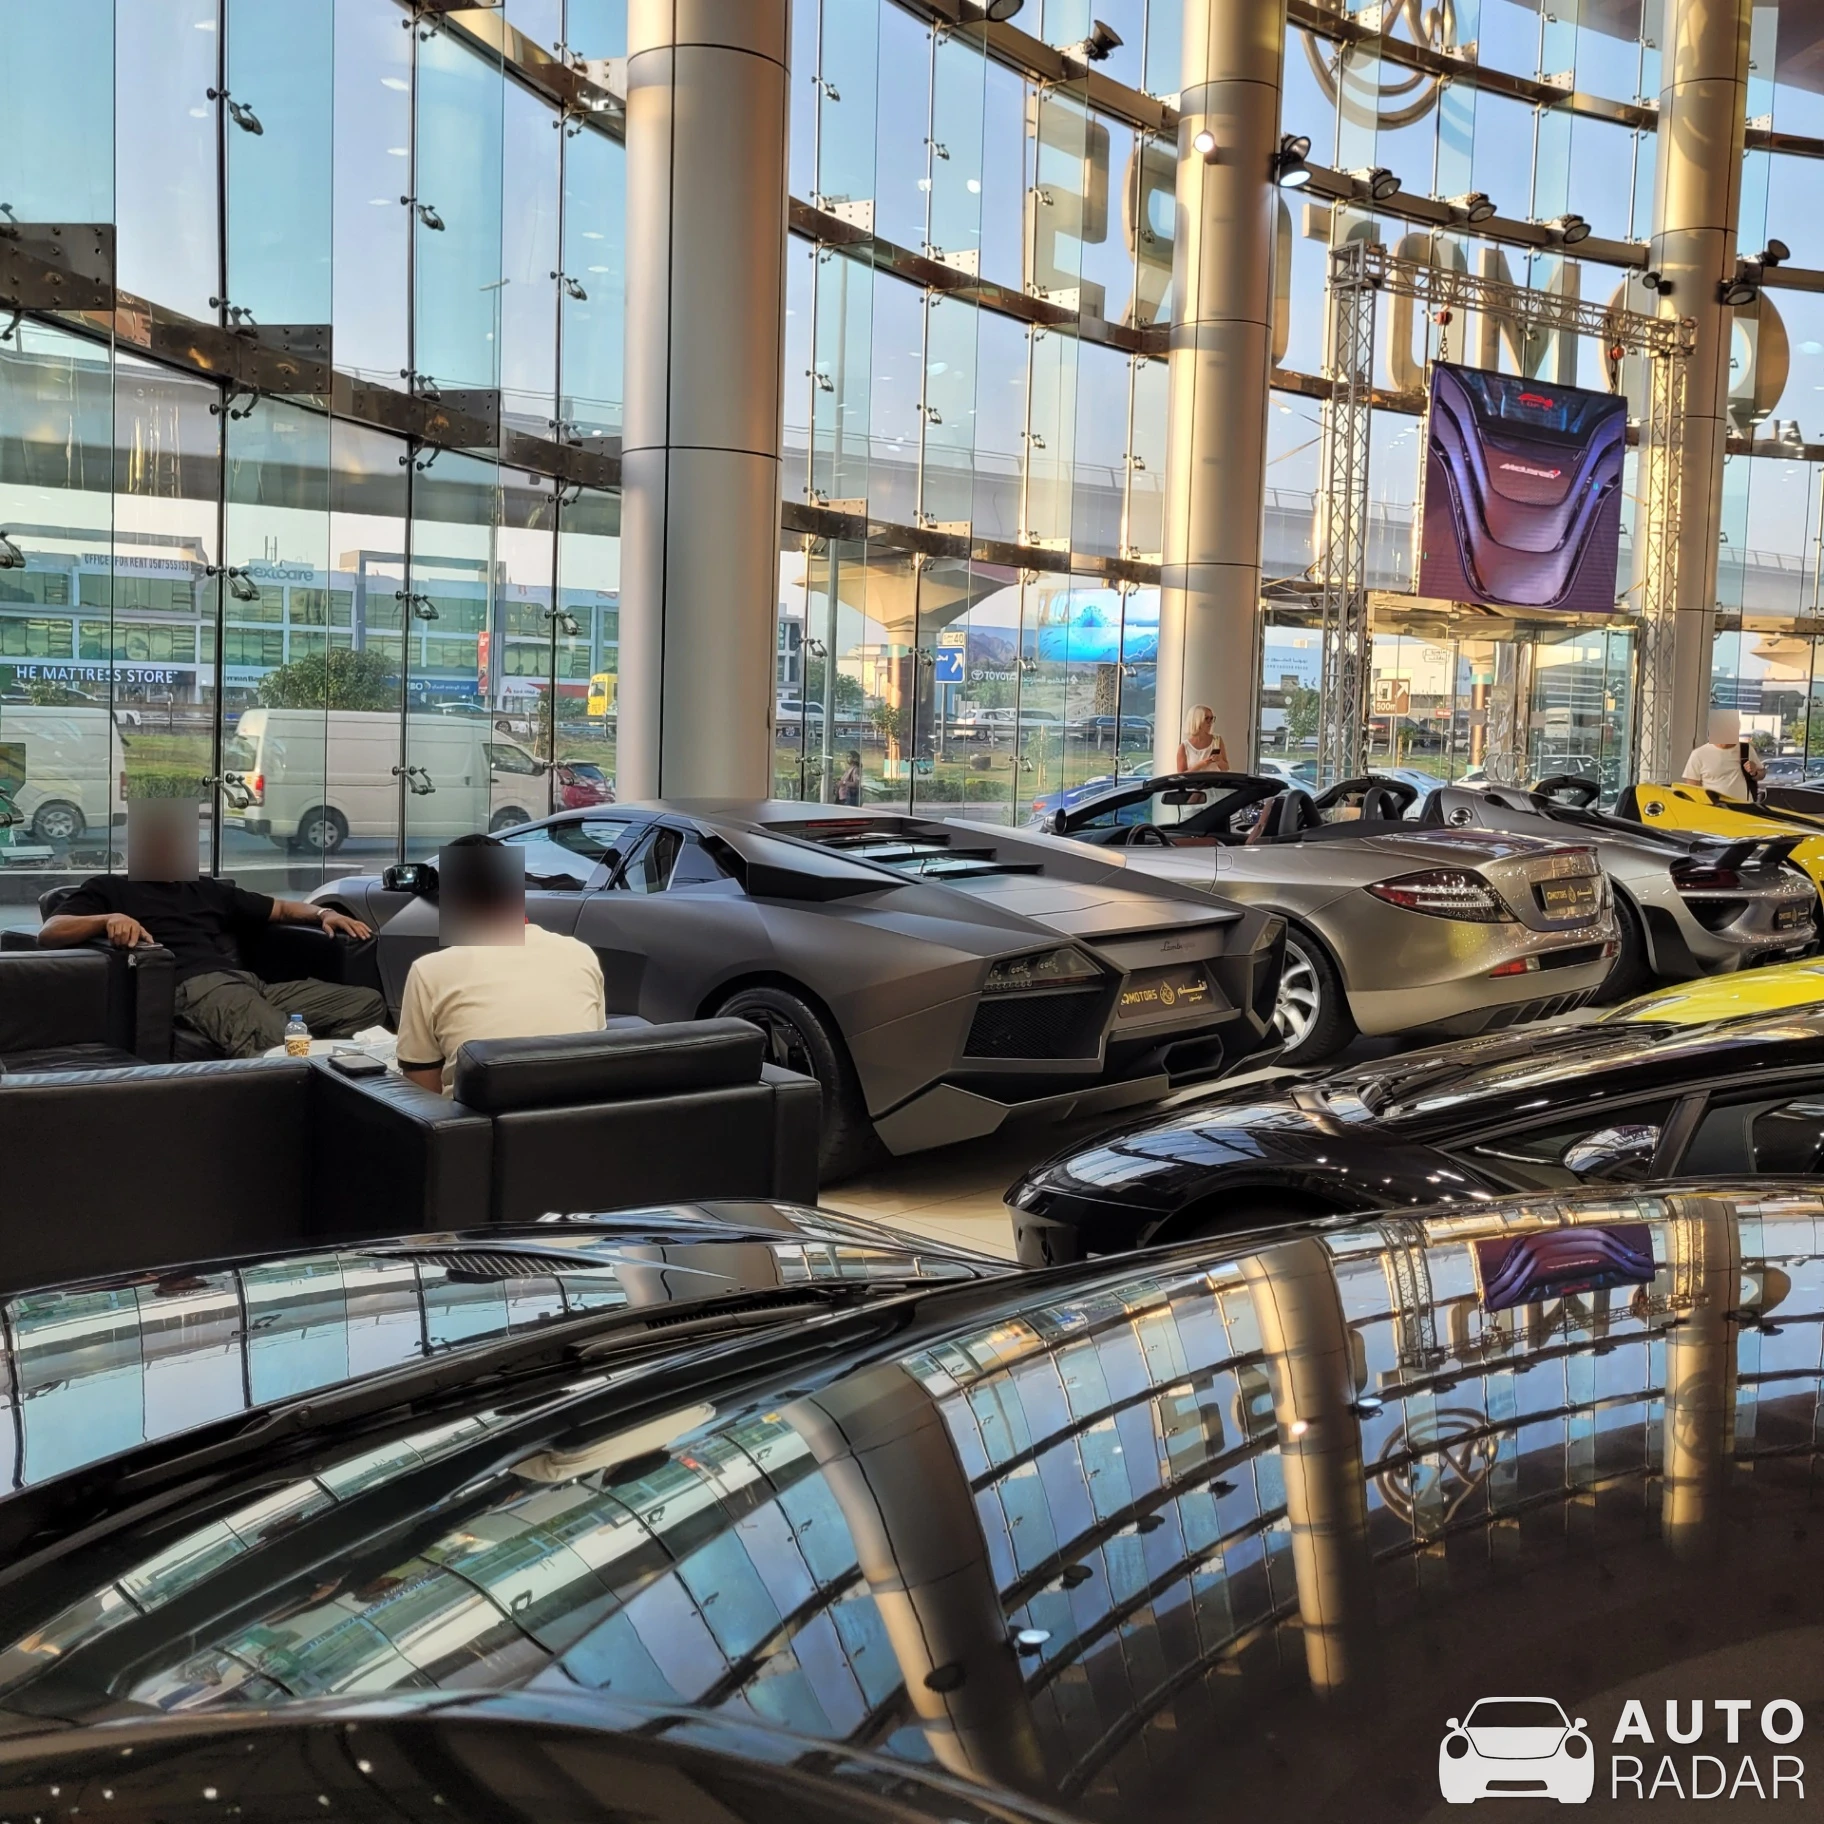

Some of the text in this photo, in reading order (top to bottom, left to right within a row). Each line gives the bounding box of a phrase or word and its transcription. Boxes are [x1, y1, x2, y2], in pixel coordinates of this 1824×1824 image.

[130, 557, 147, 569] RENT
[953, 633, 964, 644] 40
[43, 666, 121, 682] MATTRESS
[127, 668, 174, 684] STORE
